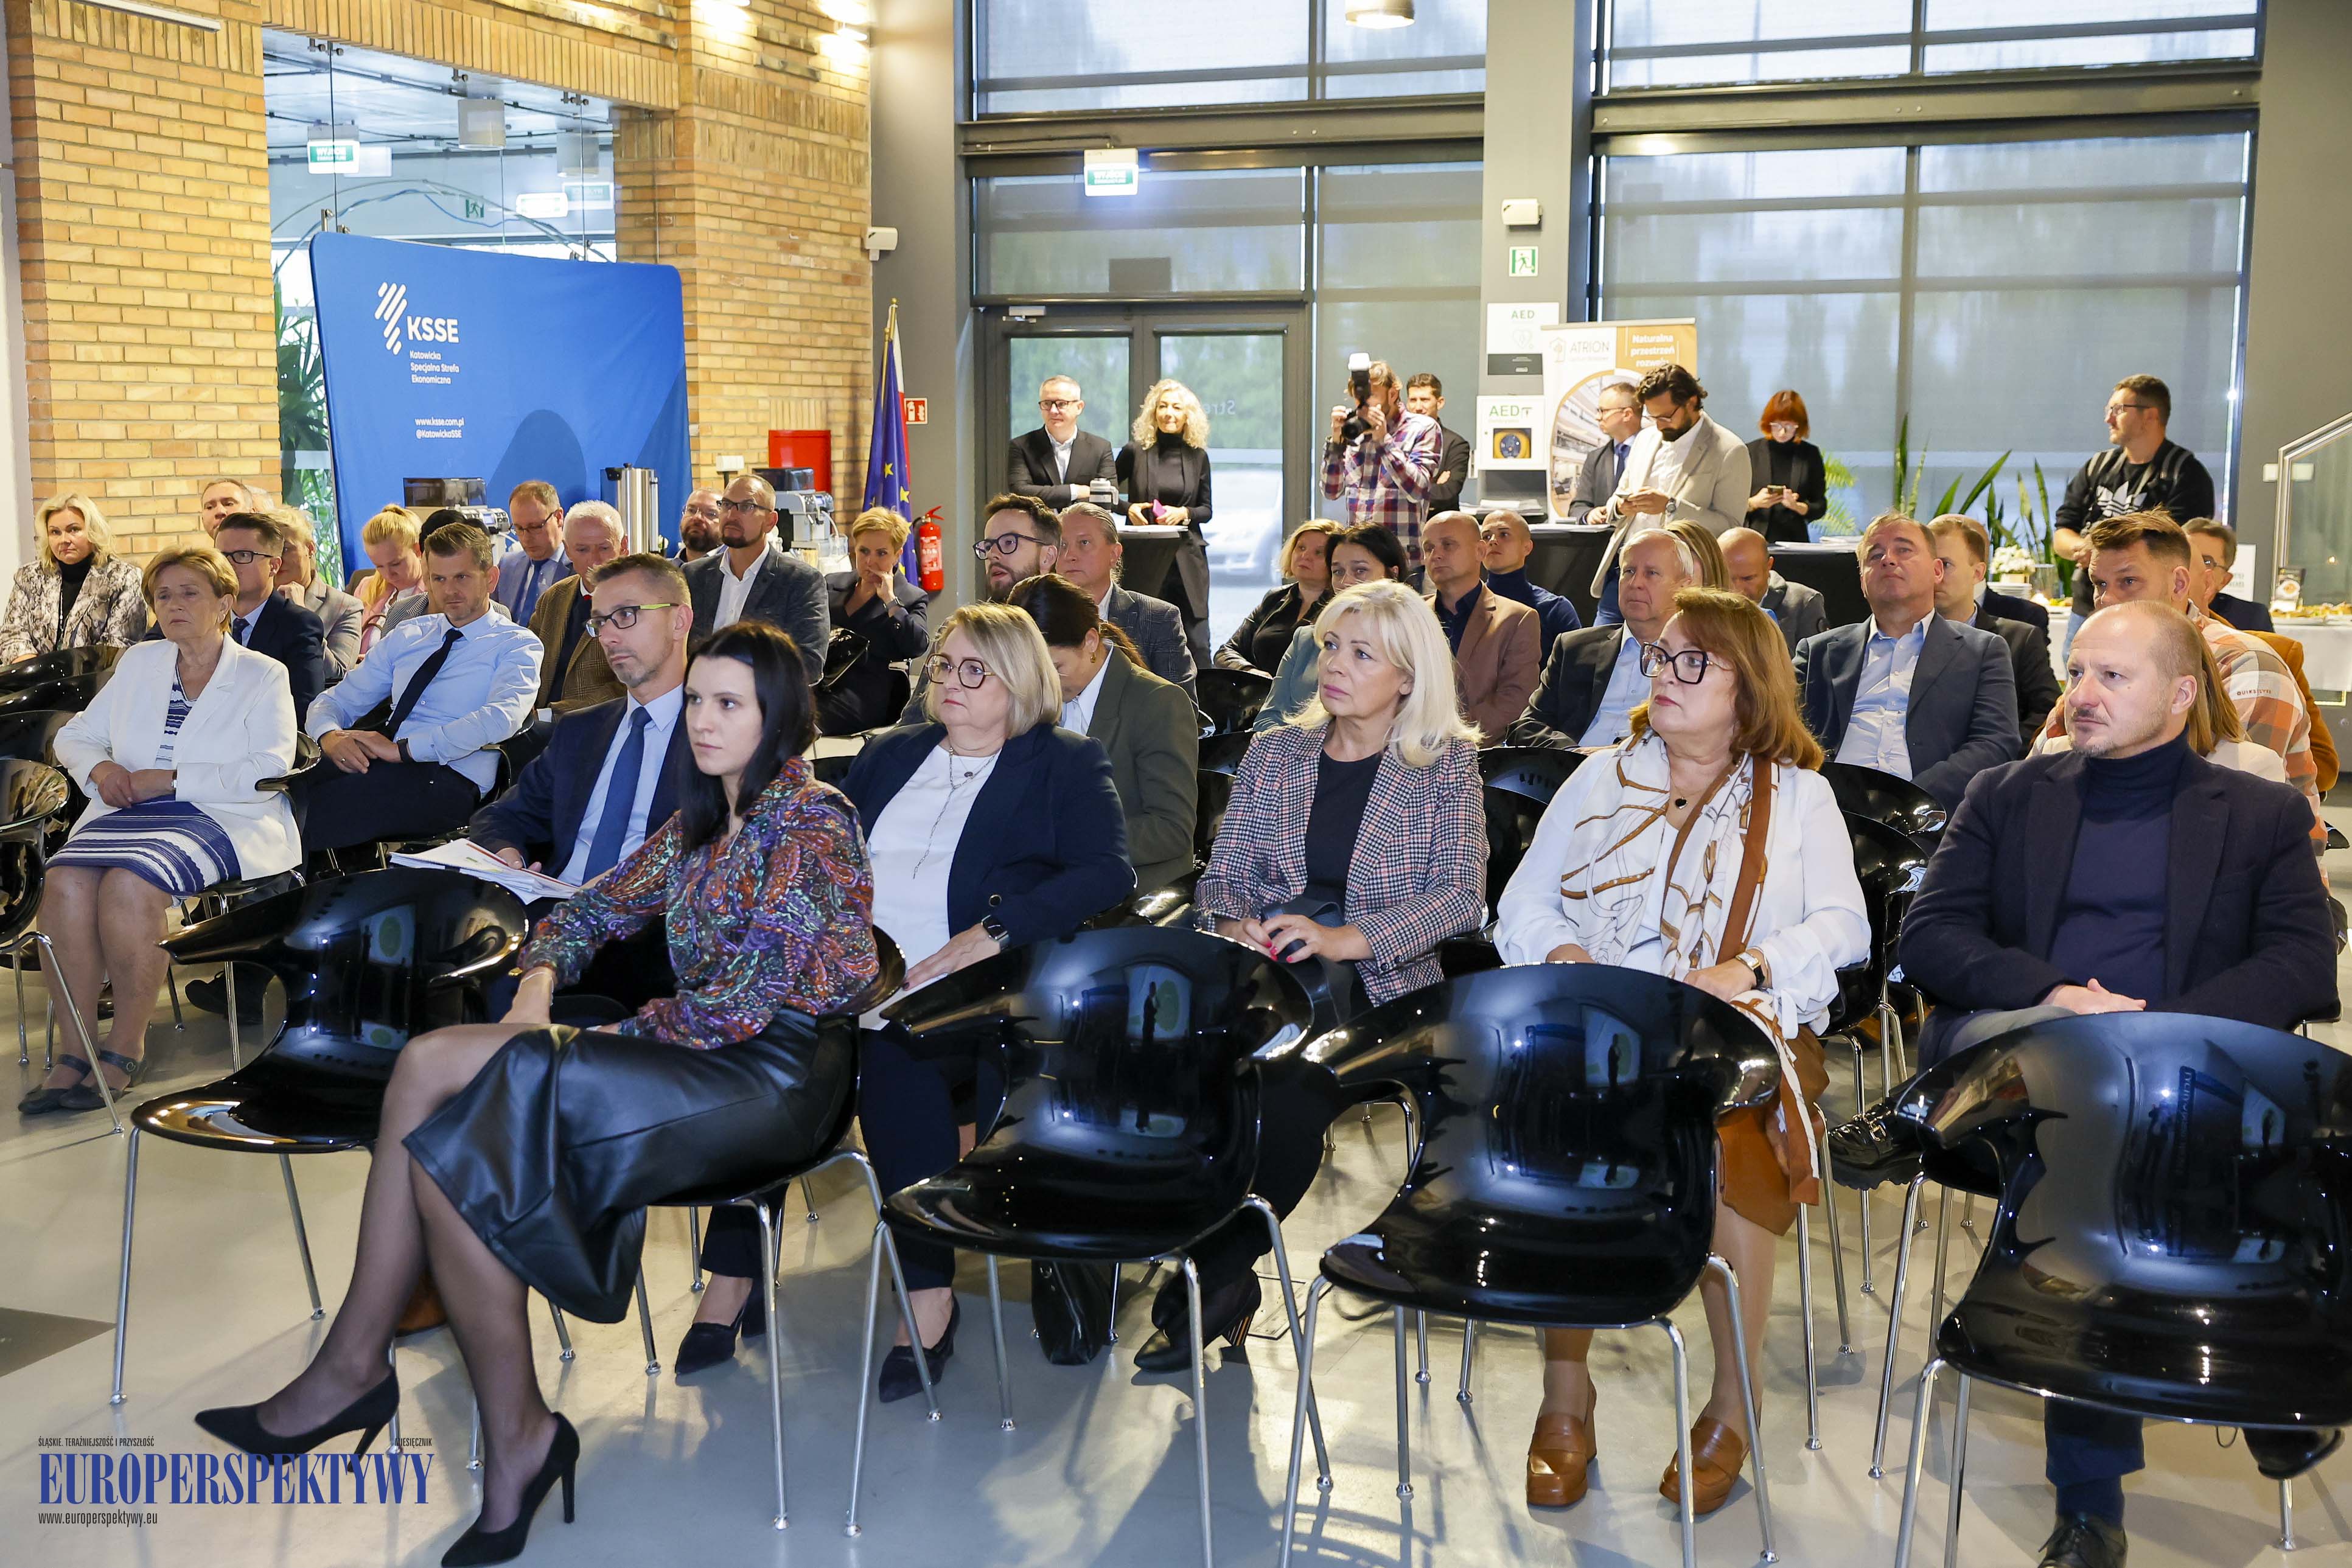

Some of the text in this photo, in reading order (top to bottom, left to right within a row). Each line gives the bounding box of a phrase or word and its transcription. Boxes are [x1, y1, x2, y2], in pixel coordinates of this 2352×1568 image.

[1512, 310, 1535, 319] AED
[407, 315, 459, 343] KSSE
[1631, 333, 1674, 344] Naturalna
[1569, 341, 1610, 354] ATRION
[1630, 345, 1675, 358] przestrzeń
[410, 350, 442, 360] Katowicka
[410, 362, 460, 374] Specjalna Strefa
[411, 374, 452, 385] Ekonomiczna
[1489, 405, 1520, 417] AED
[414, 416, 465, 428] www.ksse.com.pl
[416, 428, 462, 439] @KatowickaSSE
